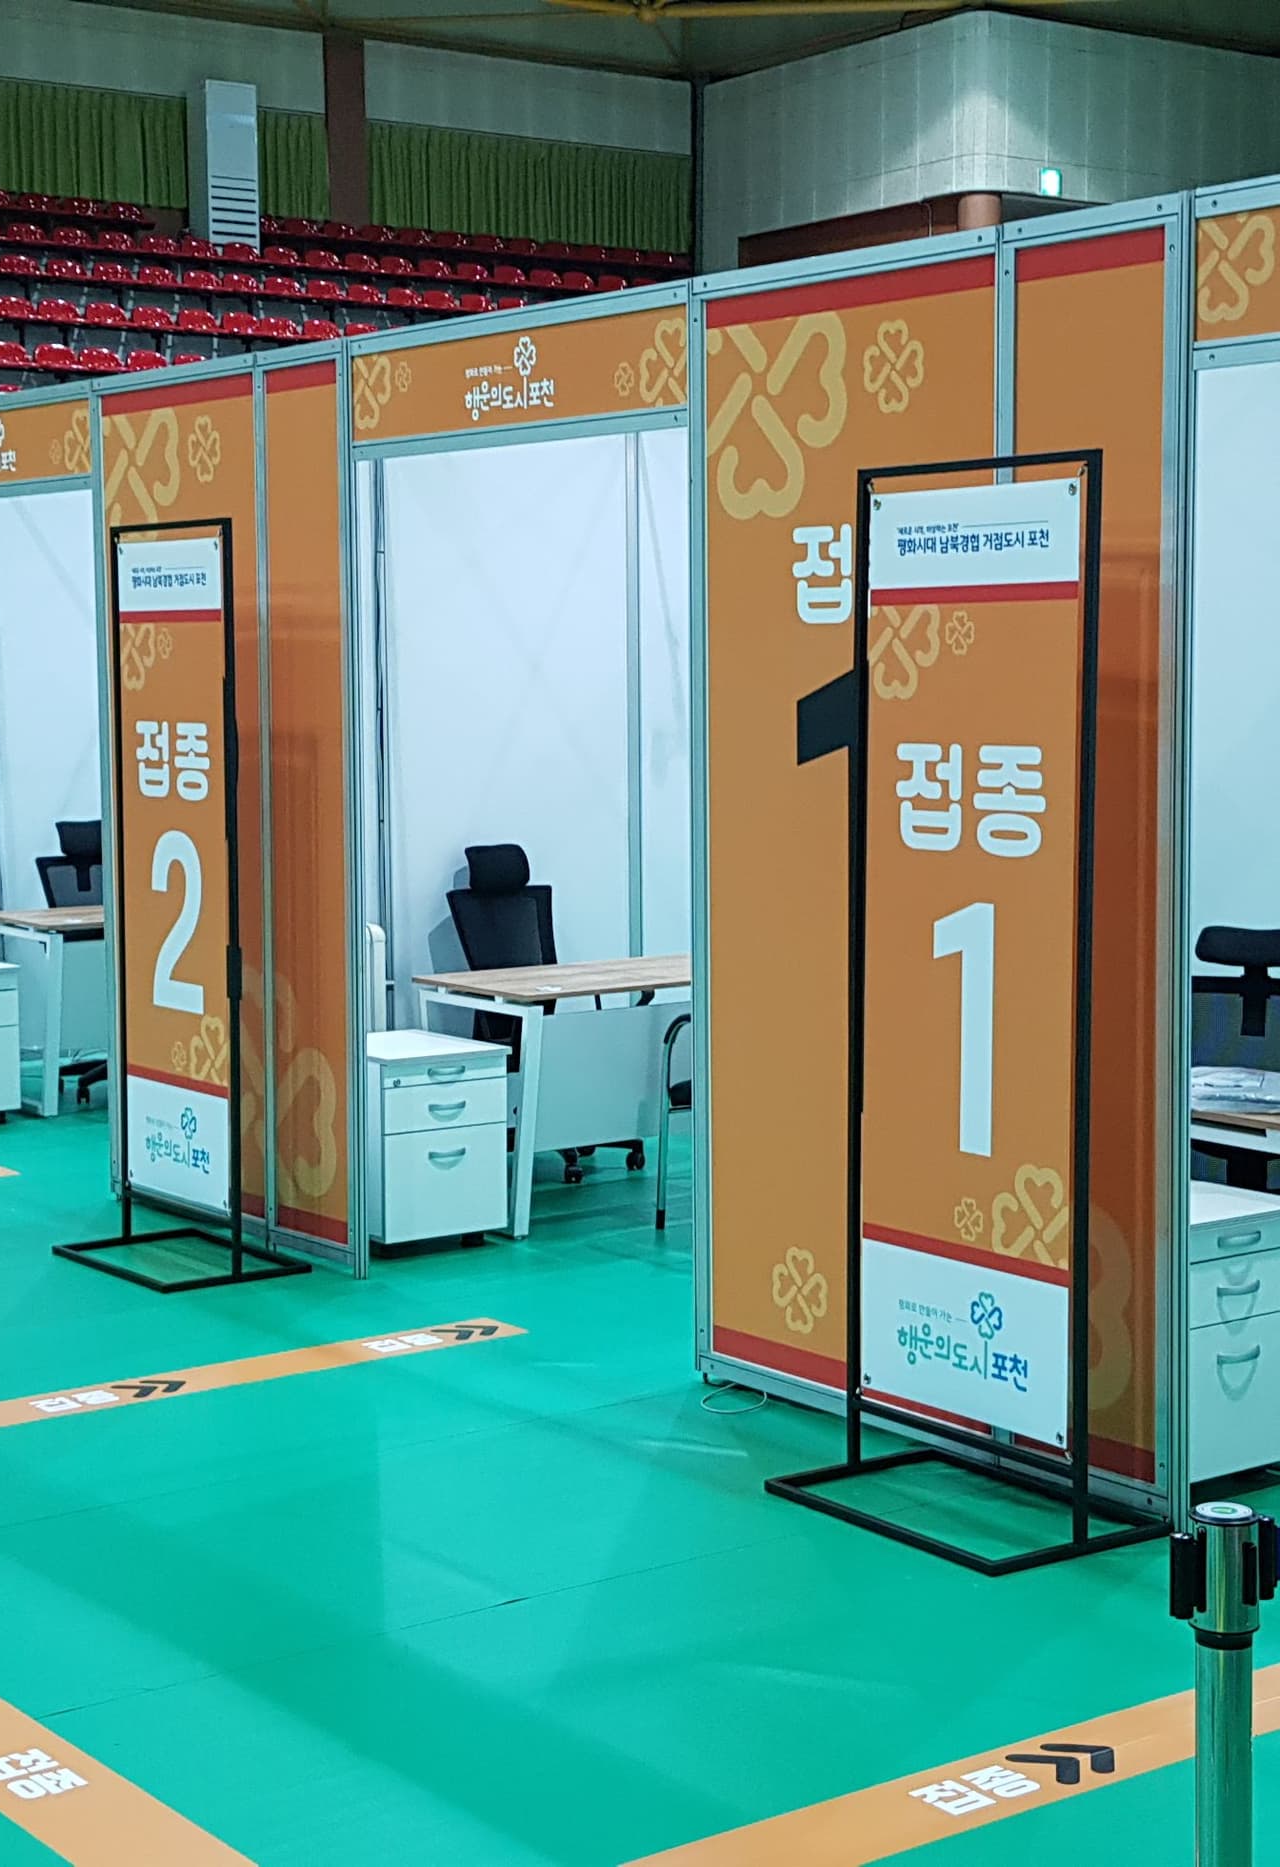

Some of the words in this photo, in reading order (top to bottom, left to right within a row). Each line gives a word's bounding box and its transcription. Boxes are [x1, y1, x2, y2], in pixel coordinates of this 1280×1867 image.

[792, 524, 854, 624] 접
[897, 537, 937, 556] 평화시대
[983, 531, 1025, 551] 거점도시
[1027, 528, 1050, 548] 포천
[135, 720, 211, 801] 접종
[896, 743, 1047, 857] 접종
[151, 829, 205, 1016] 2
[933, 902, 995, 1157] 1
[908, 1765, 1041, 1816] 접종
